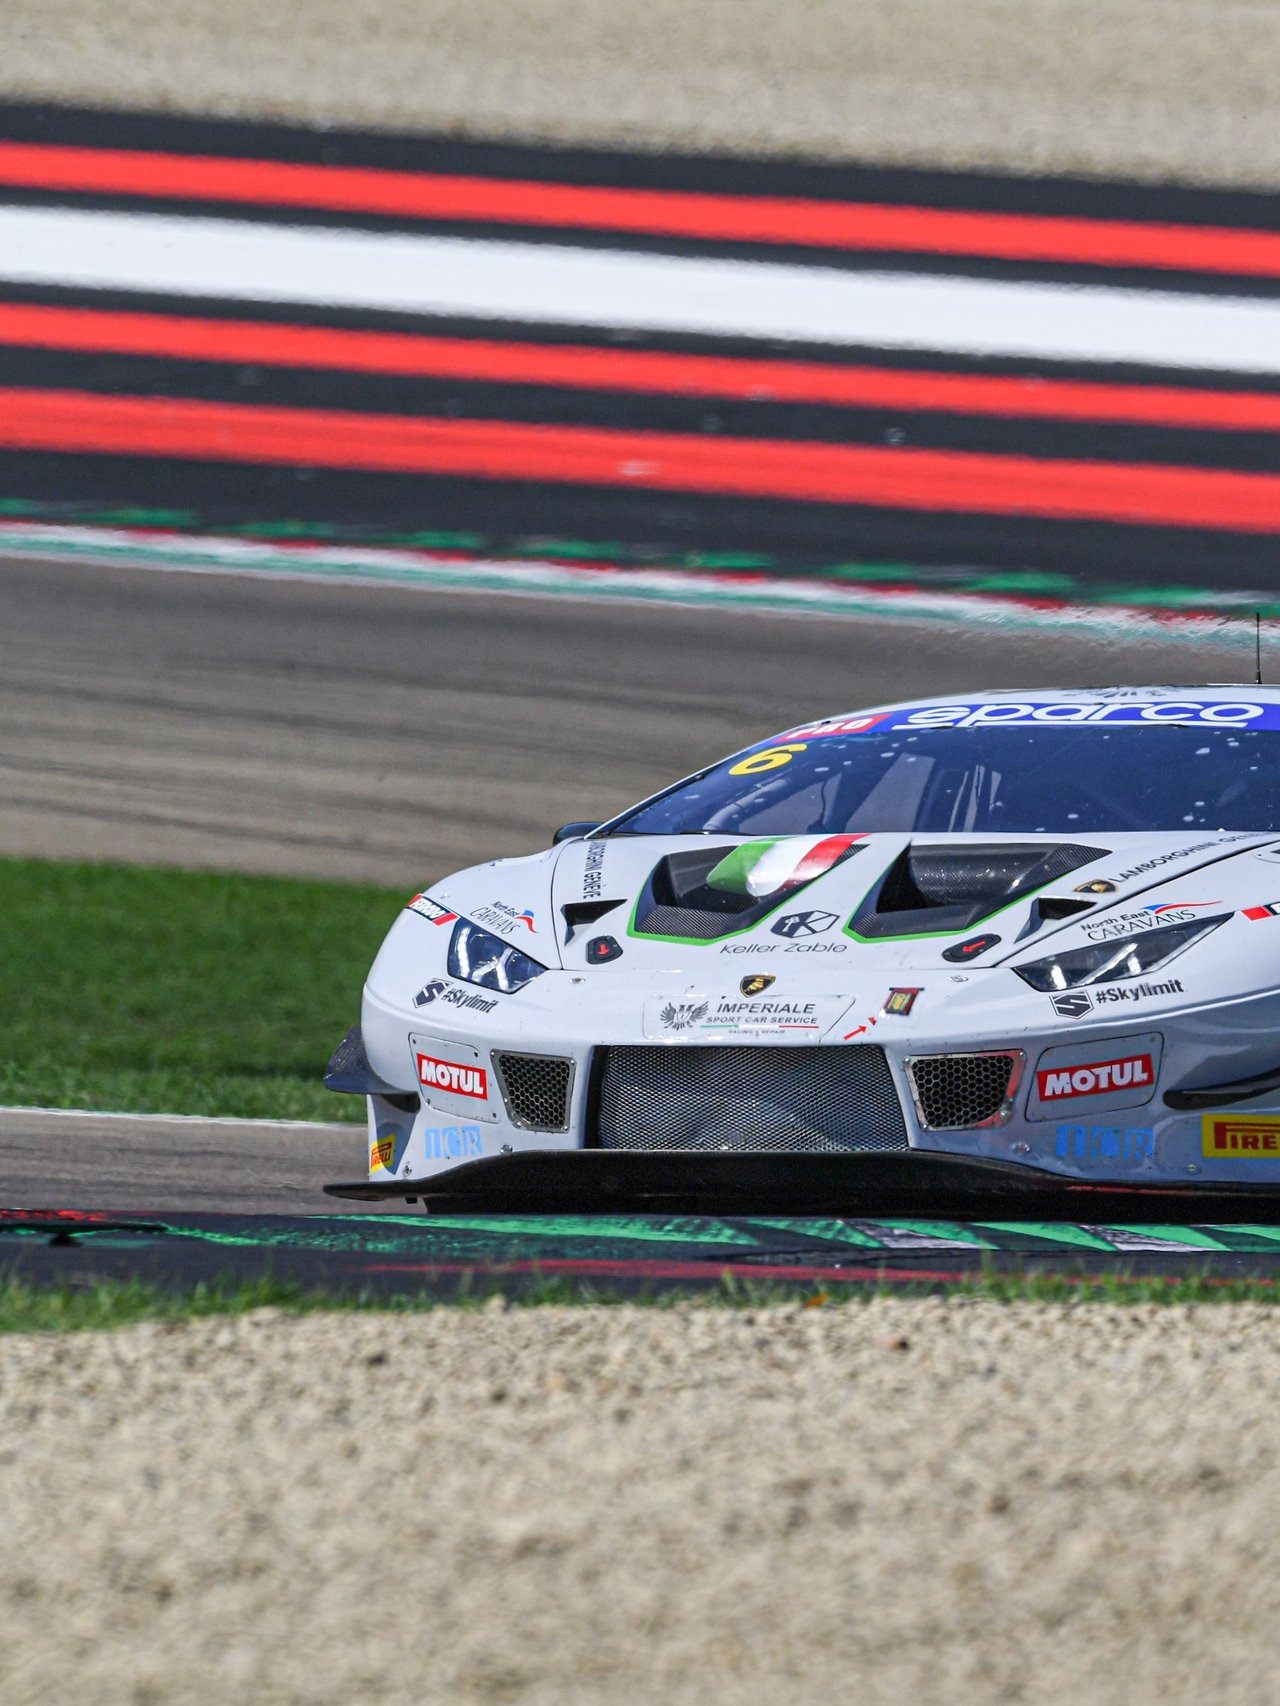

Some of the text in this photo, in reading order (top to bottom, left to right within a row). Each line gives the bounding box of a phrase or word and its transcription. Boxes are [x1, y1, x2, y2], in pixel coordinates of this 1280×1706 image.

[786, 717, 874, 738] PRO
[892, 702, 1265, 728] sparco
[728, 744, 807, 775] 6
[1108, 842, 1220, 883] LAMBORGHINI
[470, 907, 520, 934] CARAVANS
[1081, 910, 1150, 931] North East
[1087, 910, 1196, 942] CARAVANS
[720, 942, 847, 955] Keller Zable
[441, 988, 499, 1013] #Skylimit
[1096, 979, 1185, 1004] #Skylimit
[706, 1016, 818, 1024] SPORT CAR SERVICE
[717, 1003, 816, 1014] IMPERIALE
[421, 1059, 484, 1095] MOTUL
[1044, 1060, 1148, 1096] MOTUL
